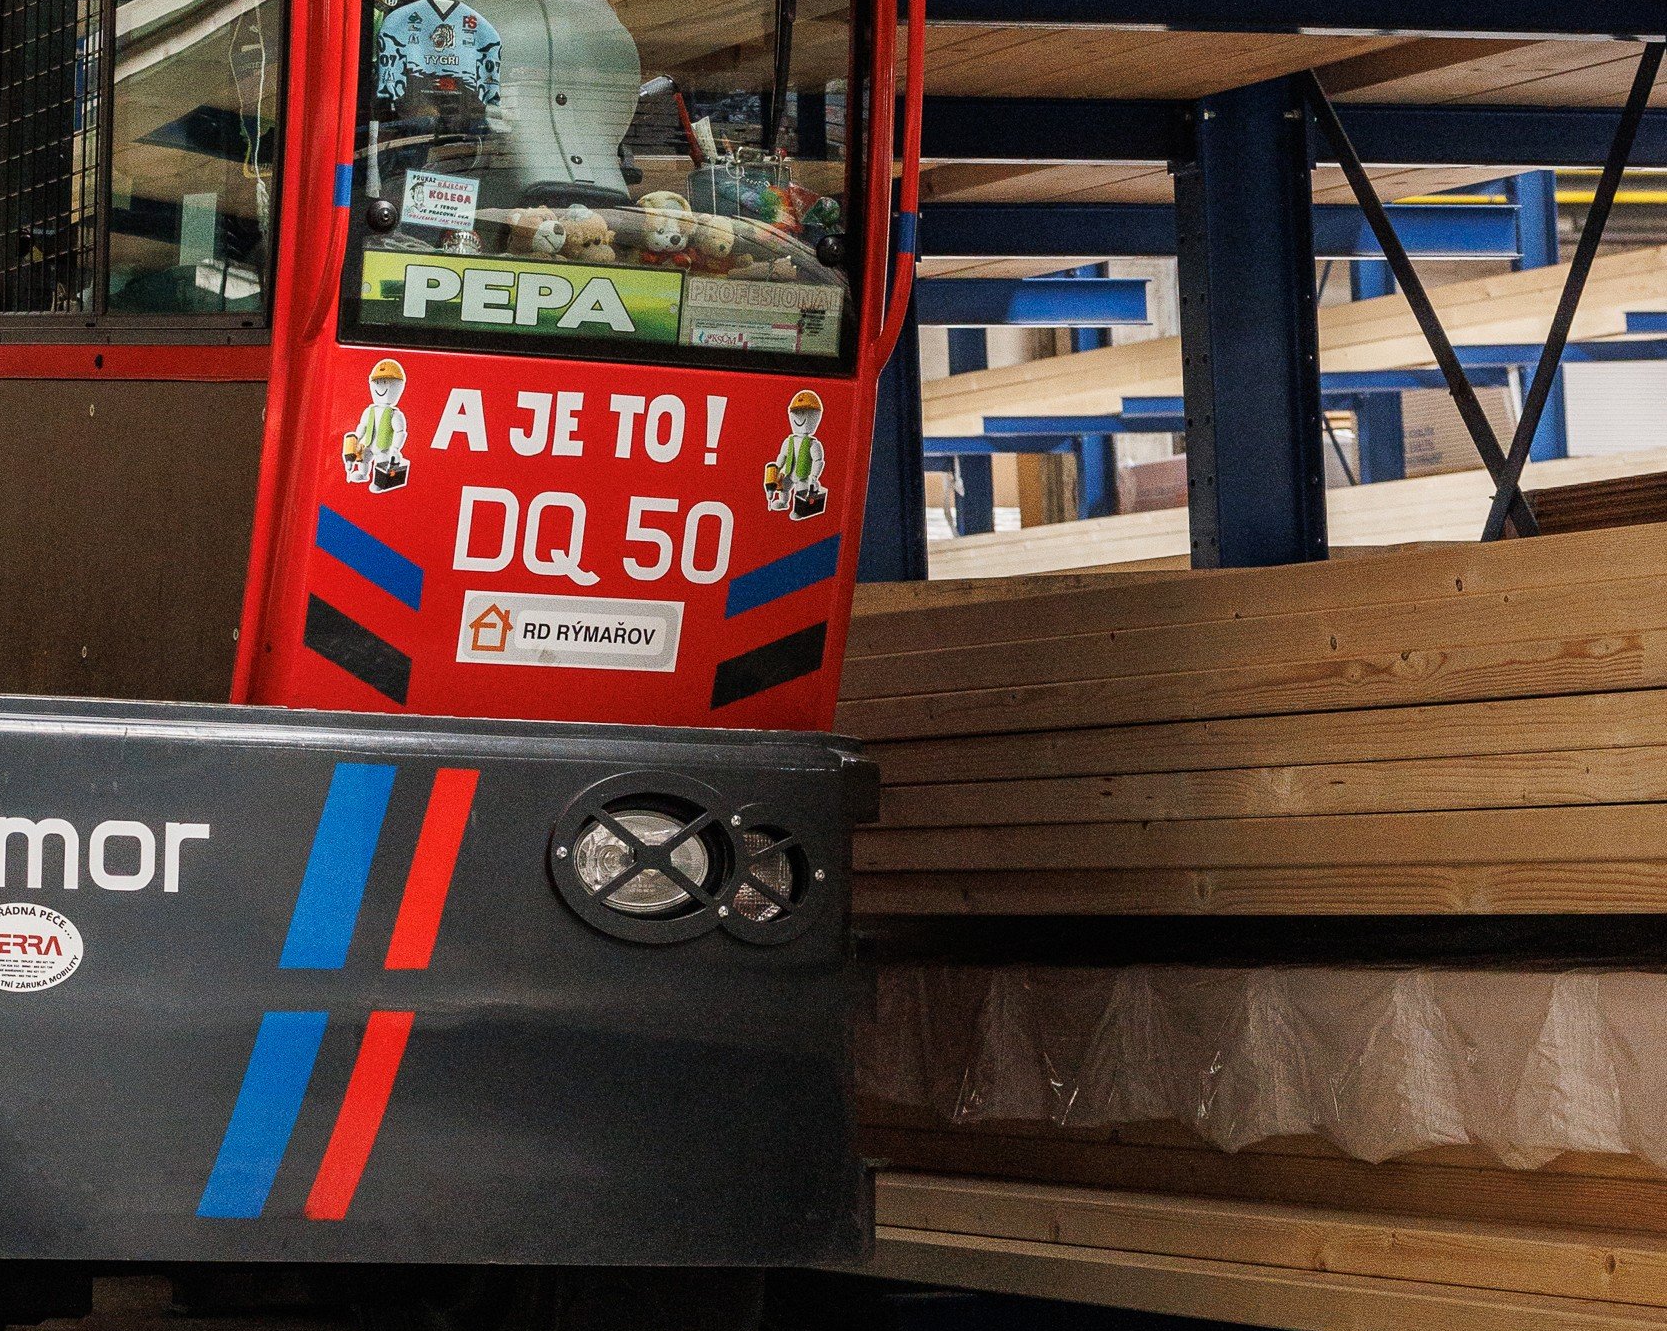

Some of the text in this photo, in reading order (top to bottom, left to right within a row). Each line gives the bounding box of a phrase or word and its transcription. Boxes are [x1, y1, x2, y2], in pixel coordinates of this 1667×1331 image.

[403, 264, 635, 332] PEPA
[430, 388, 488, 452] A
[509, 390, 584, 457] JE
[609, 394, 685, 462] TO
[452, 486, 734, 585] DQ 50
[522, 621, 656, 645] RD RÝMAŘOV
[15, 980, 48, 989] ZÁRUKA
[49, 954, 79, 984] MOBILITY
